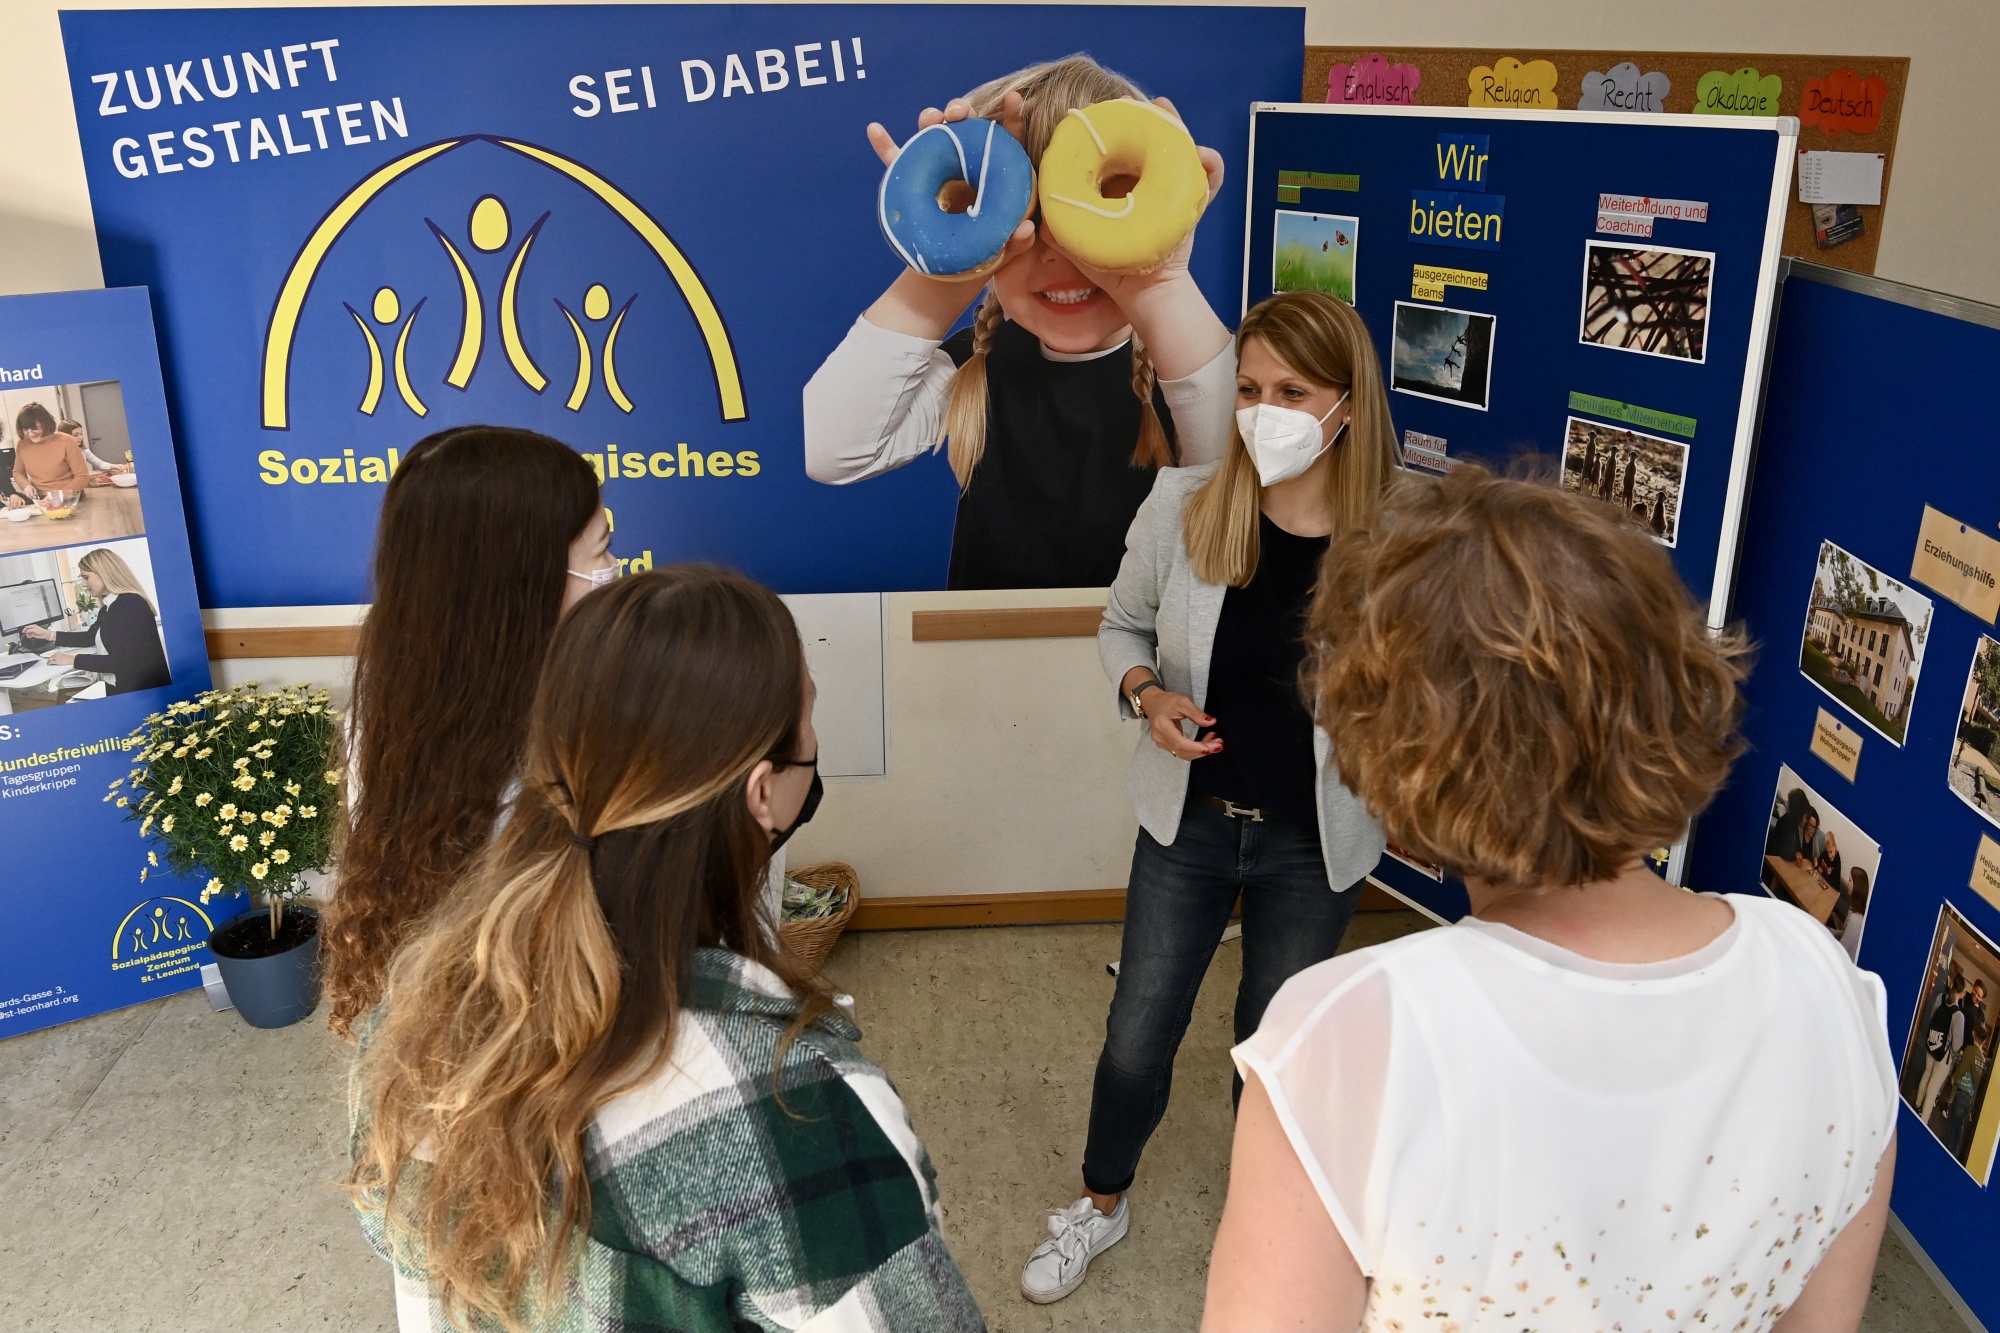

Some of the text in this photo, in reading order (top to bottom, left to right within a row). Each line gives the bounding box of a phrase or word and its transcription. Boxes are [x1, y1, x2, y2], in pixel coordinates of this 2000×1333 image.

[91, 38, 340, 117] ZUKUNFT
[568, 36, 867, 119] SEI DABEI!
[1343, 74, 1411, 105] Englisch
[1481, 74, 1541, 110] Religion
[1600, 78, 1653, 112] Recht
[1706, 80, 1767, 117] Ökologie
[1808, 89, 1874, 118] Deutsch
[112, 96, 409, 179] GESTALTEN
[1436, 143, 1489, 182] Wir
[1410, 199, 1502, 242] bieten
[1599, 196, 1708, 220] Weiterbildung und
[1596, 216, 1653, 238] Coaching
[1411, 283, 1444, 300] Teams
[1413, 267, 1488, 288] ausgezeichnete
[1405, 432, 1447, 452] Raum für
[258, 443, 761, 487] Sozialgisches
[1924, 539, 1996, 589] Erziehungshilfe
[1, 763, 81, 786] Tagesgruppen
[2, 777, 77, 799] Kinderkrippe
[147, 956, 191, 972] Zentrum
[157, 962, 200, 980] Leonhard
